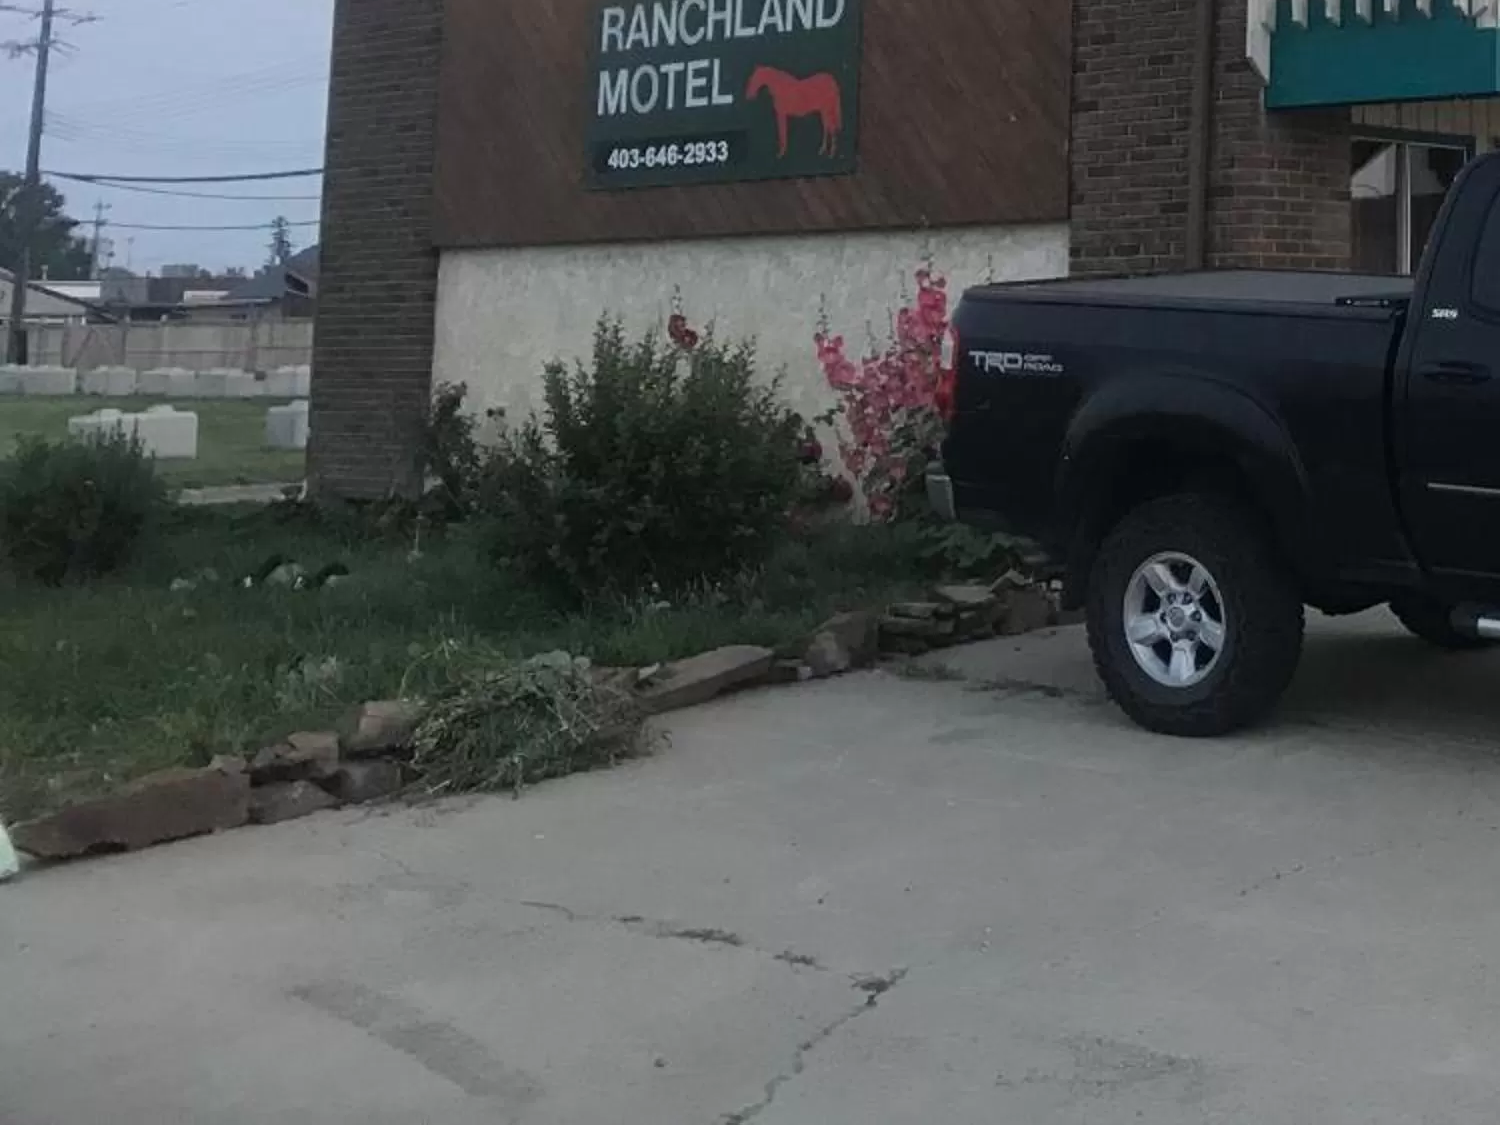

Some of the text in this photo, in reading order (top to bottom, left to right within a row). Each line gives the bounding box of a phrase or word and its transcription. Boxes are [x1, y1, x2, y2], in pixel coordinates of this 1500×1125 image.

[597, 58, 733, 116] MOTEL
[607, 140, 729, 169] 403-646-2933
[968, 350, 1022, 373] TRD
